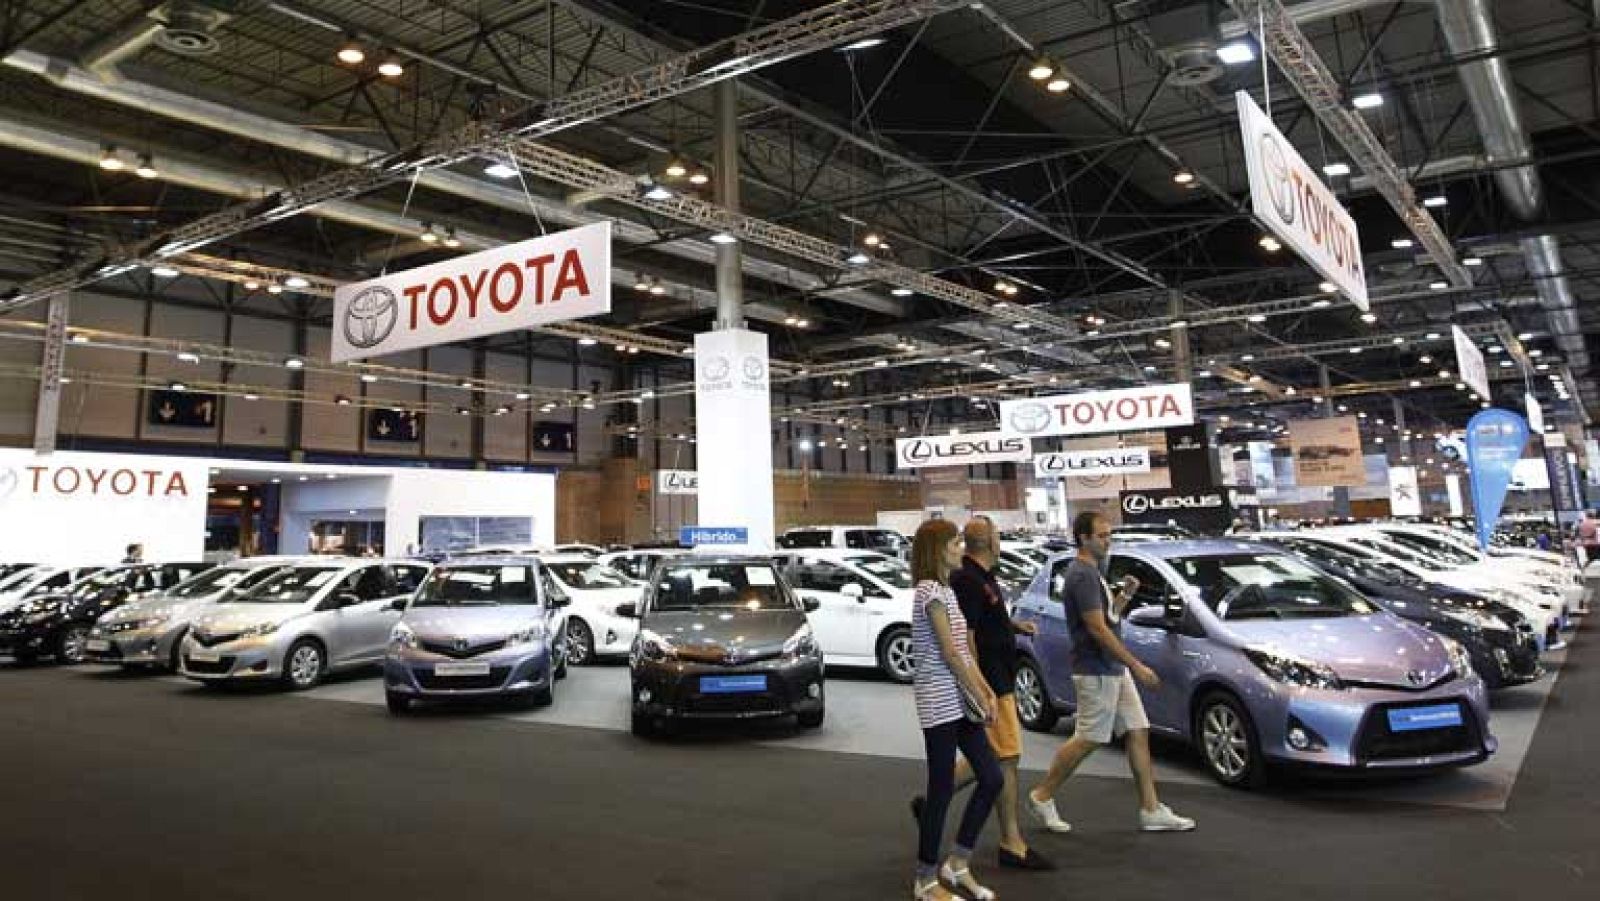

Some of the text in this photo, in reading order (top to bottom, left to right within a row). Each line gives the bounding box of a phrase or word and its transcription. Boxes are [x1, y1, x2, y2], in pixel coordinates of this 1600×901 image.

[1292, 168, 1363, 288] TOYOTA
[403, 248, 591, 331] TOYOTA
[1054, 394, 1182, 426] TOYOTA
[935, 437, 1024, 457] LEXUS
[1068, 454, 1143, 470] LEXUS
[25, 466, 188, 496] TOYOTA
[1149, 494, 1222, 510] LEXUS
